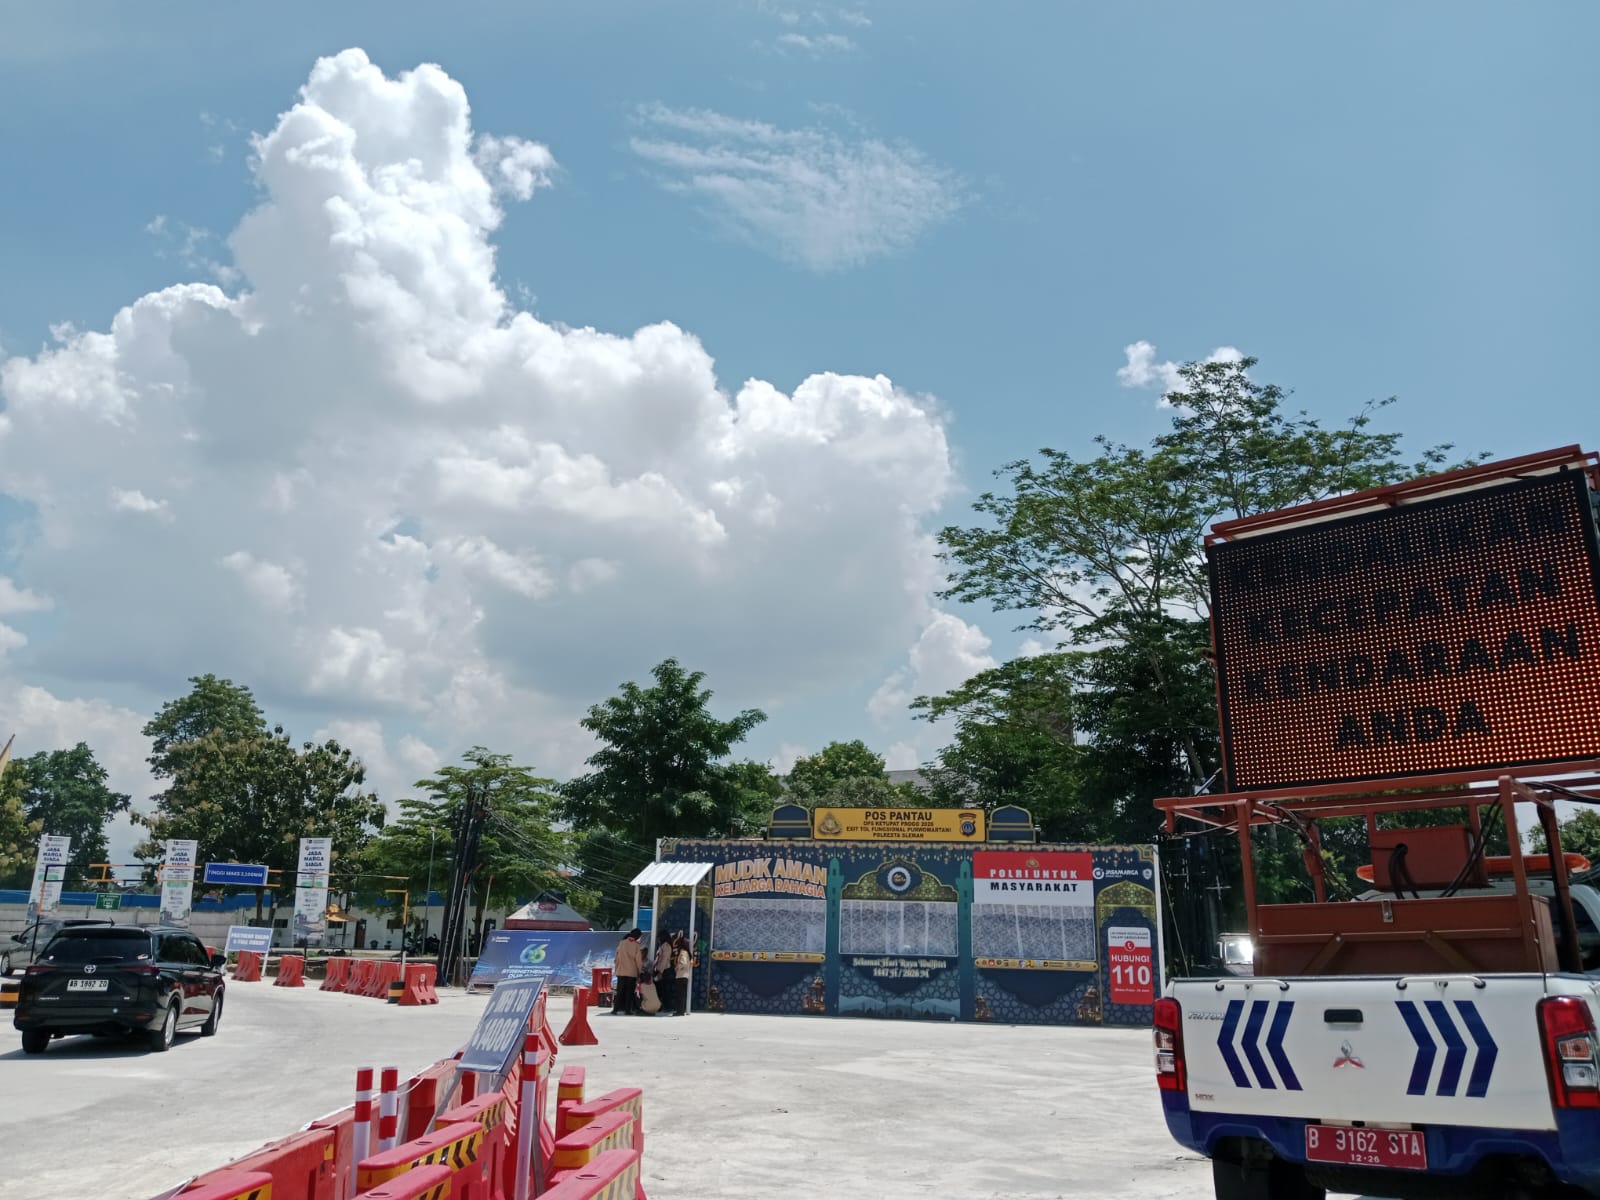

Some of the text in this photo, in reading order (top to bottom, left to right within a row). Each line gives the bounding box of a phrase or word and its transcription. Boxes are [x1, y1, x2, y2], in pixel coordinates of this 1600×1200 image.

[1229, 497, 1565, 594] KENDALIKAN
[1246, 559, 1560, 647] KECEPATAN
[1243, 620, 1579, 706] KENDARAAN
[1334, 699, 1493, 753] ANDA
[865, 811, 932, 821] POS PANTAU
[714, 857, 828, 886] MUDIK AMAN
[990, 869, 1078, 879] POLRI UNTUK
[714, 878, 827, 899] KELUARGA BAHAGIA
[990, 882, 1078, 892] MASYARAKAT
[1111, 954, 1150, 963] HUBUNGI
[1112, 964, 1151, 985] 110
[475, 1018, 520, 1052] 14080
[1308, 1127, 1319, 1149] B
[1387, 1132, 1421, 1156] STA
